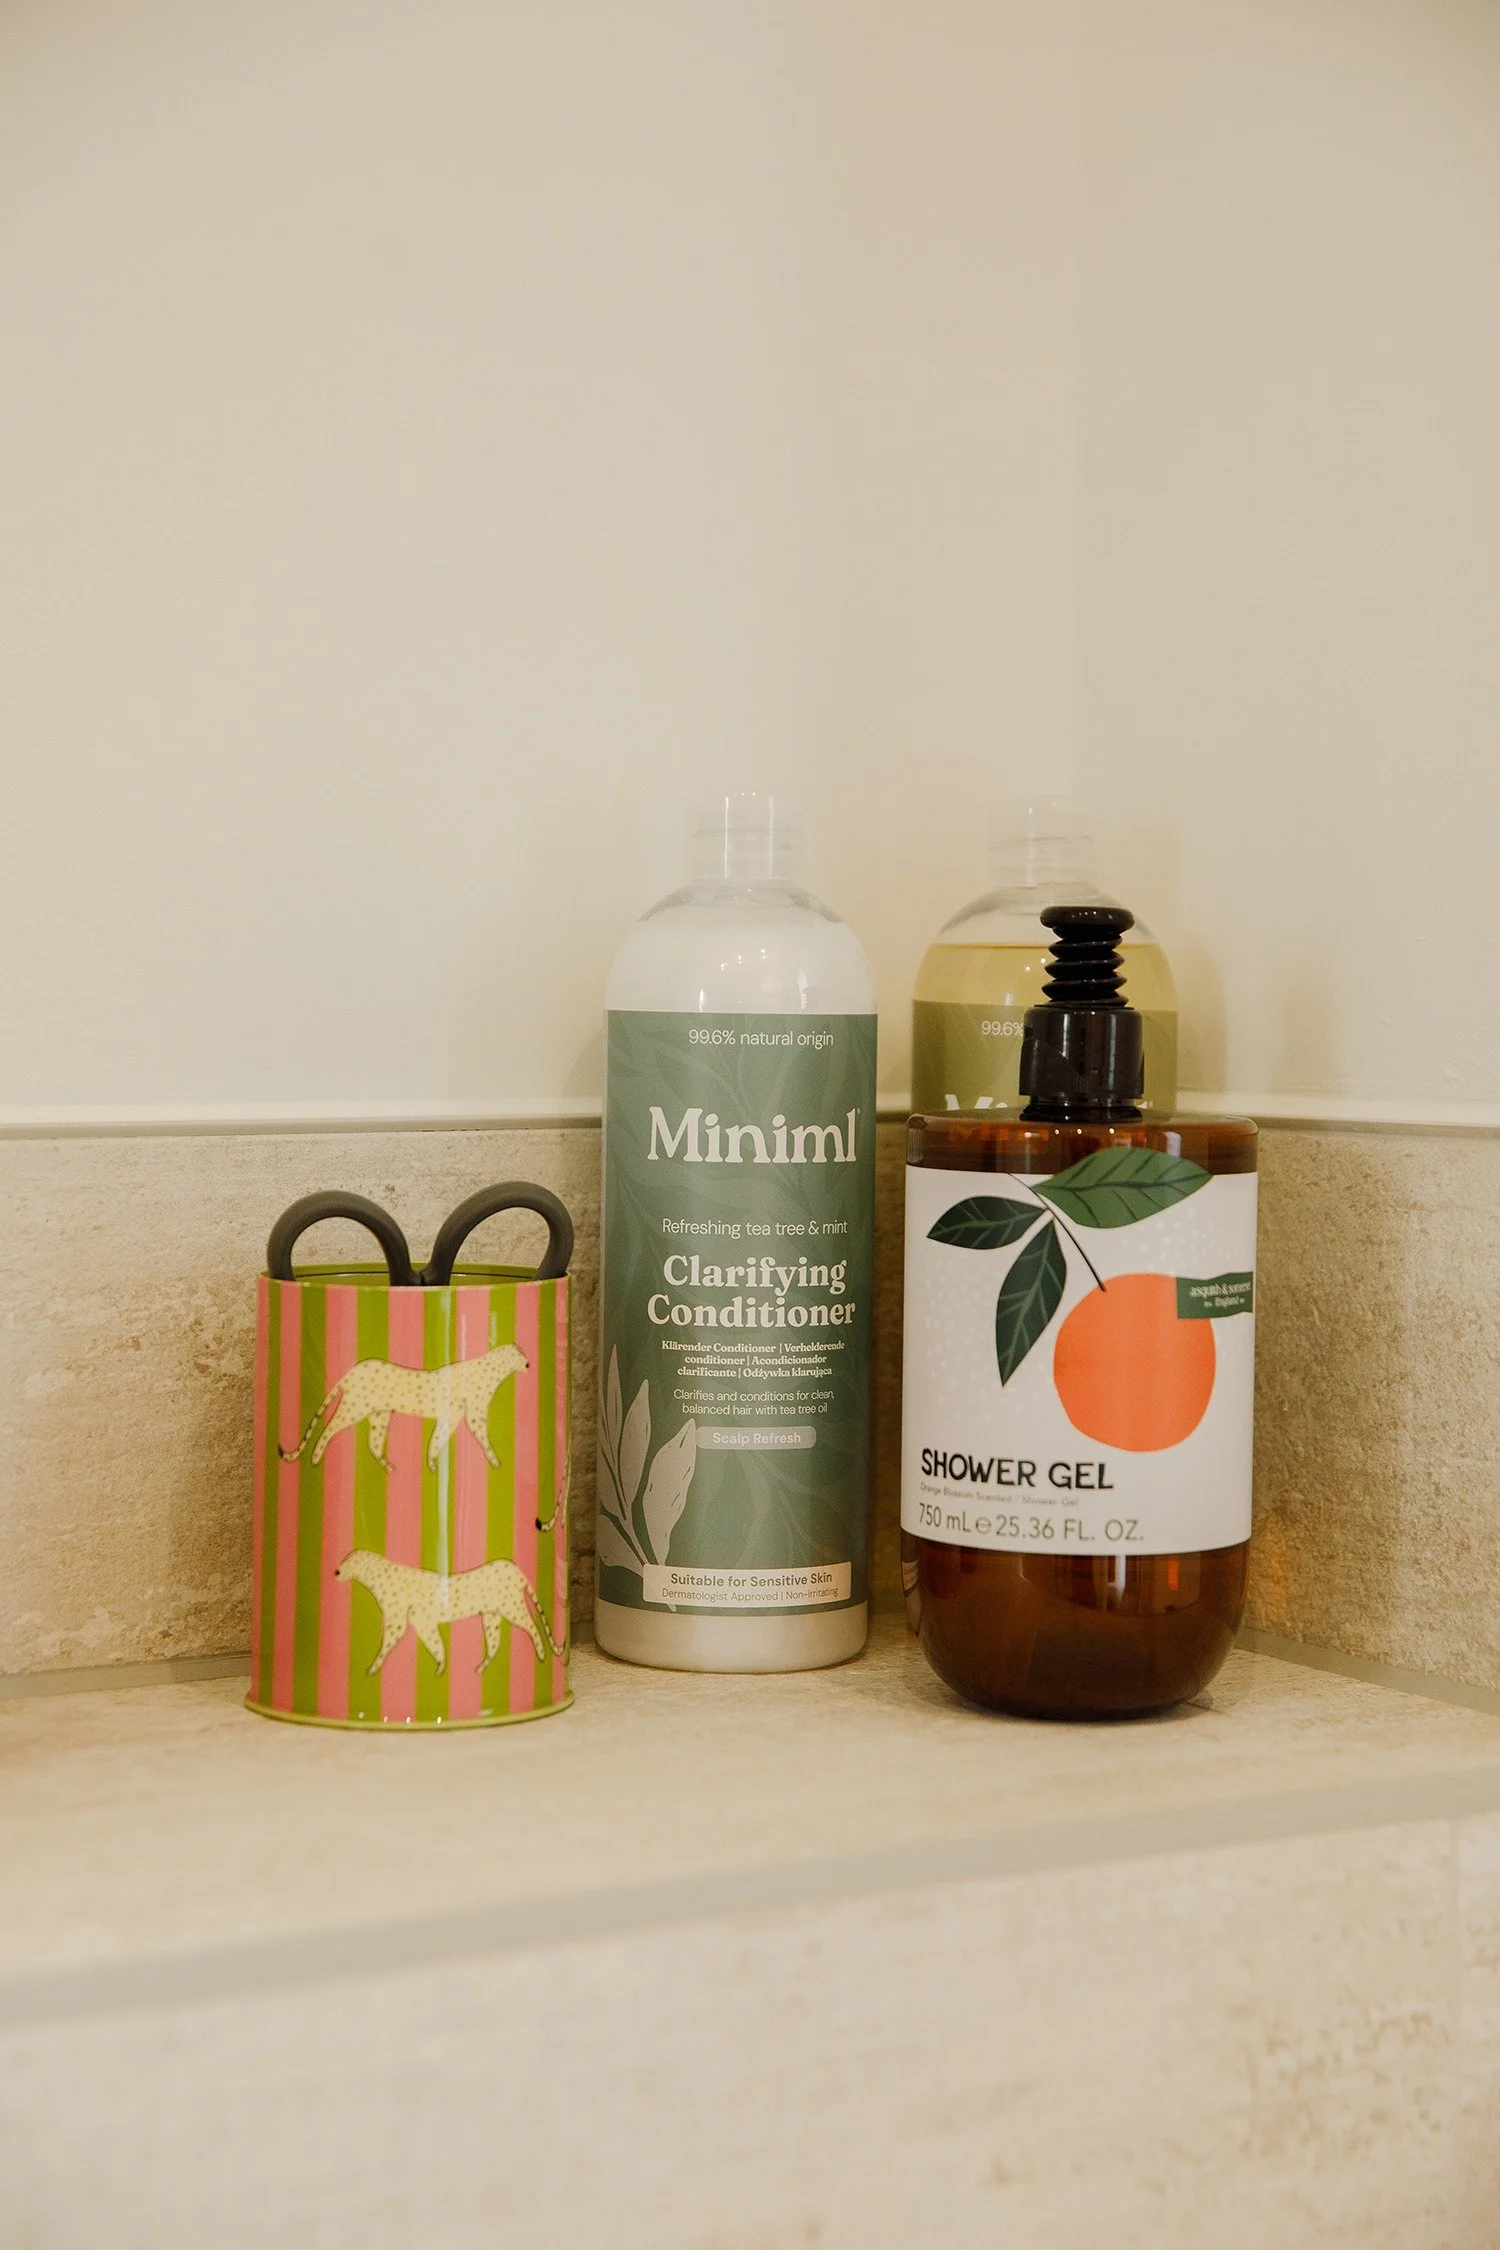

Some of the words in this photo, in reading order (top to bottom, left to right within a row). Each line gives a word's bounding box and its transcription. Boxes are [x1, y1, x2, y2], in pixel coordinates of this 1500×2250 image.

[981, 1020, 1024, 1036] 99.6%
[688, 1029, 736, 1045] 99.6%
[740, 1031, 793, 1046] natural
[797, 1031, 834, 1050] origin
[647, 1106, 857, 1163] Miniml
[662, 1218, 741, 1239] Refreshing
[746, 1221, 771, 1236] tea
[775, 1221, 805, 1235] tree
[808, 1220, 819, 1235] &
[822, 1219, 848, 1234] mint
[663, 1254, 847, 1297] Clarifying
[647, 1293, 856, 1328] Conditioner
[661, 1340, 712, 1352] Klärender
[713, 1343, 776, 1353] Conditioner
[784, 1341, 845, 1353] Verhelderende
[684, 1355, 745, 1366] conditioner
[752, 1355, 827, 1365] Acondicionador
[677, 1366, 736, 1378] clarificante
[673, 1389, 714, 1401] Clarifies
[717, 1391, 738, 1402] and
[739, 1391, 795, 1402] conditions
[796, 1390, 810, 1400] for
[682, 1403, 731, 1415] balanced
[732, 1404, 753, 1415] hair
[755, 1403, 778, 1415] with
[780, 1404, 797, 1414] tea
[798, 1404, 817, 1414] tree
[818, 1403, 828, 1413] oil
[712, 1433, 750, 1447] Scalp
[753, 1433, 801, 1444] Refresh
[921, 1448, 1036, 1487] SHOWER
[1048, 1462, 1114, 1490] GEL
[919, 1503, 942, 1527] 750
[946, 1511, 971, 1533] mL
[996, 1513, 1055, 1540] 25.36
[1063, 1518, 1095, 1541] FL.
[1104, 1519, 1144, 1541] OZ.
[670, 1573, 725, 1587] Suitable
[728, 1574, 747, 1587] for
[750, 1574, 808, 1587] Sensitive
[810, 1572, 832, 1584] Skin
[661, 1588, 729, 1602] Dermatologist
[730, 1591, 779, 1603] Approved
